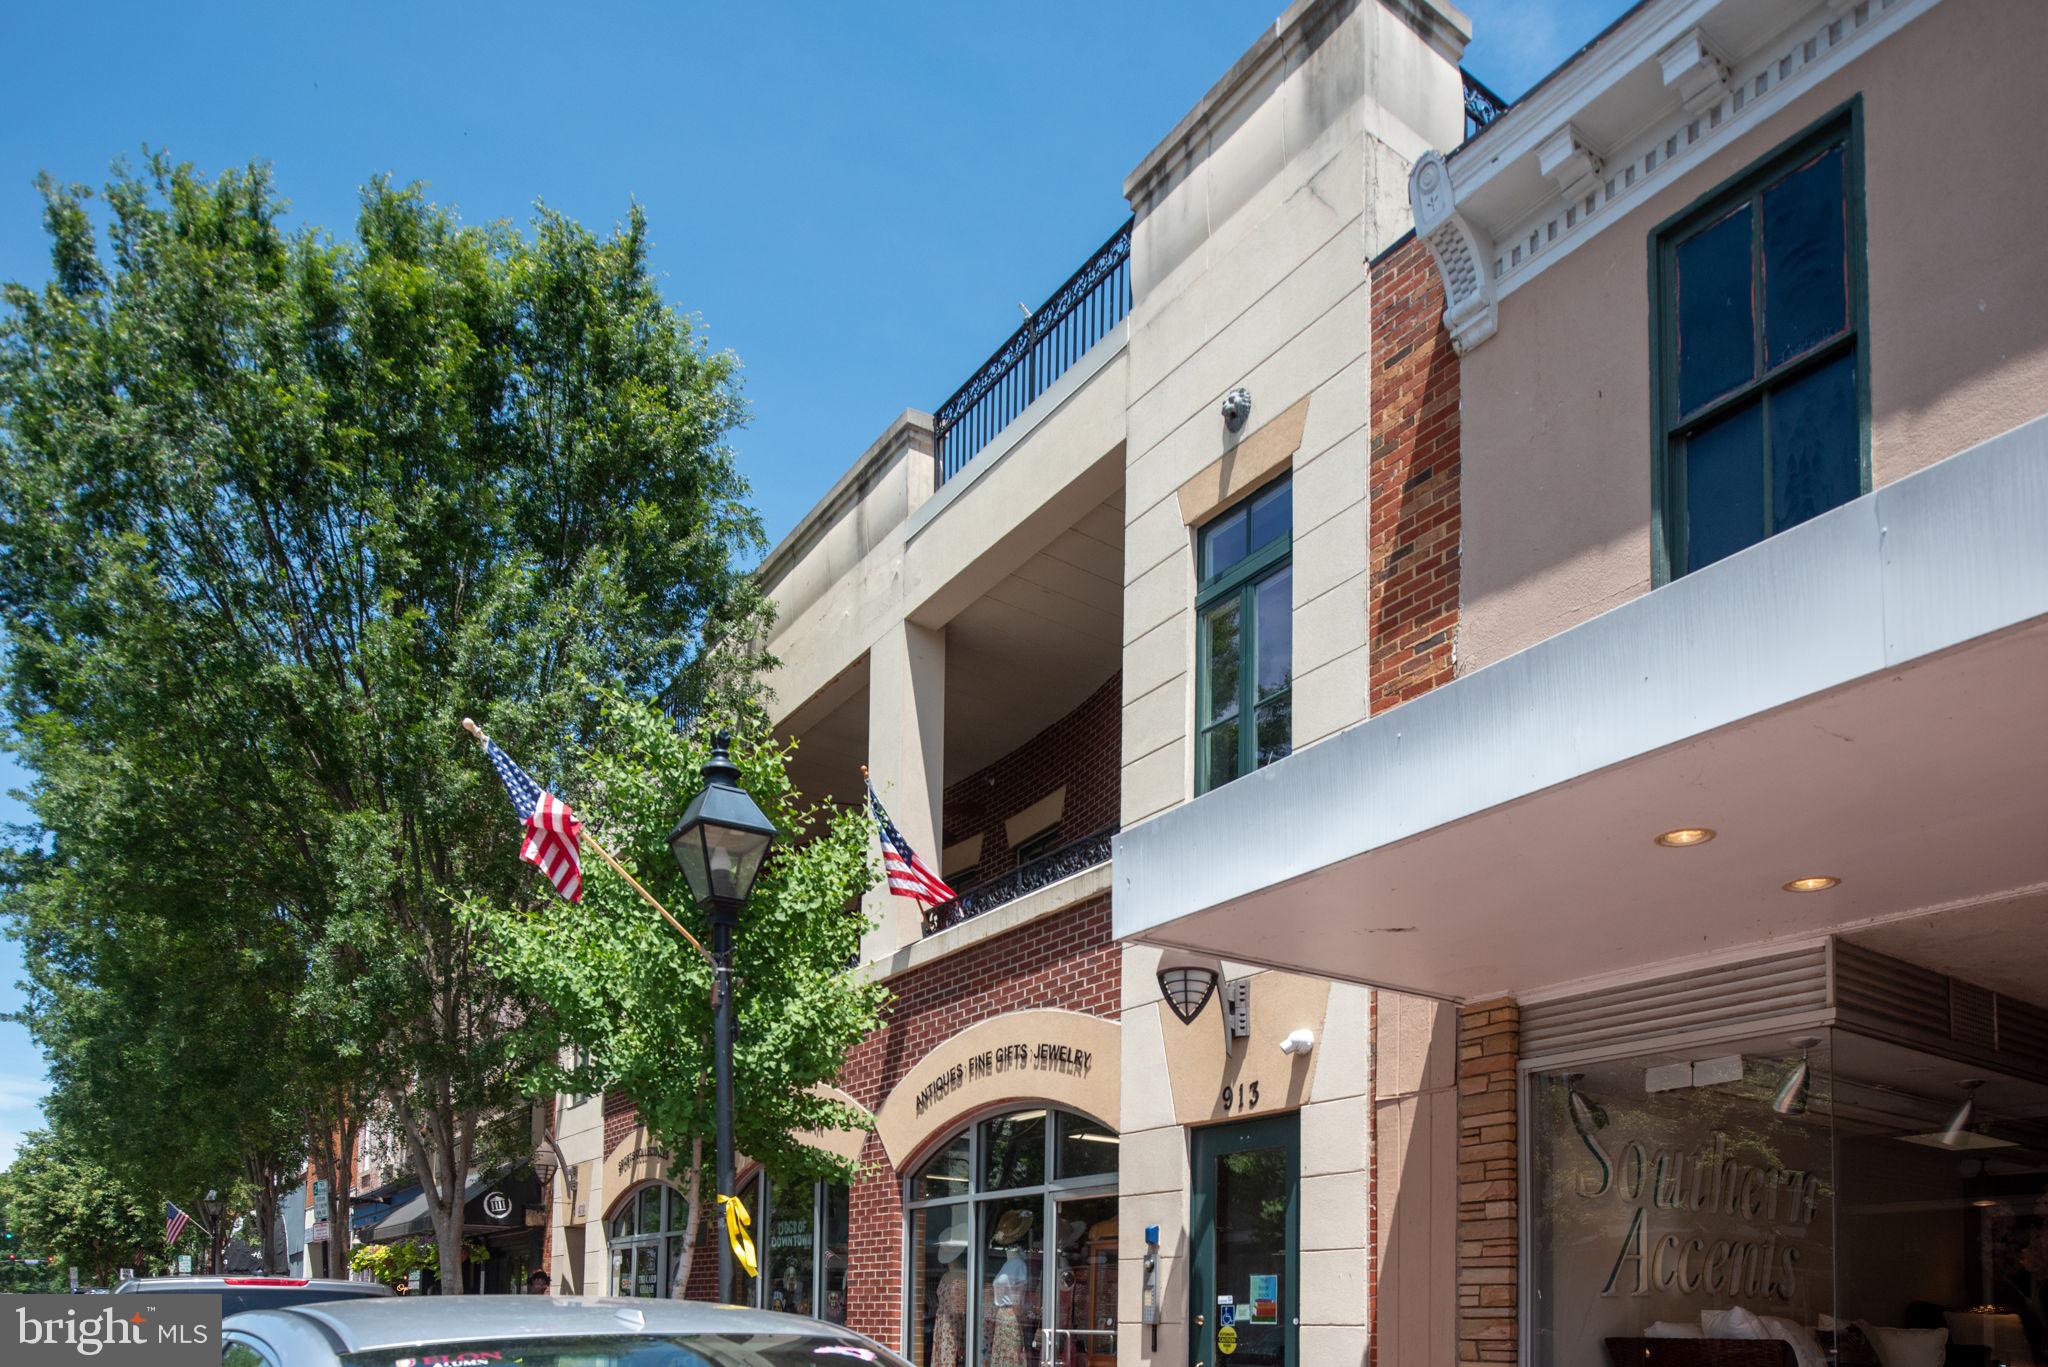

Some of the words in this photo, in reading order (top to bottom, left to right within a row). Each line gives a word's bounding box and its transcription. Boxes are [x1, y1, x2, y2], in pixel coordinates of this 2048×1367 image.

[915, 1063, 964, 1107] ANTIQUES
[968, 1051, 993, 1072] FINE
[995, 1043, 1028, 1063] GIFTS
[1033, 1043, 1092, 1069] JEWELRY
[1222, 1080, 1259, 1110] 913
[1575, 1130, 1818, 1224] Southern
[771, 1233, 813, 1248] DOWNTOWN
[778, 1220, 797, 1235] DOGS
[797, 1220, 807, 1233] OF
[1600, 1206, 1800, 1299] Accents
